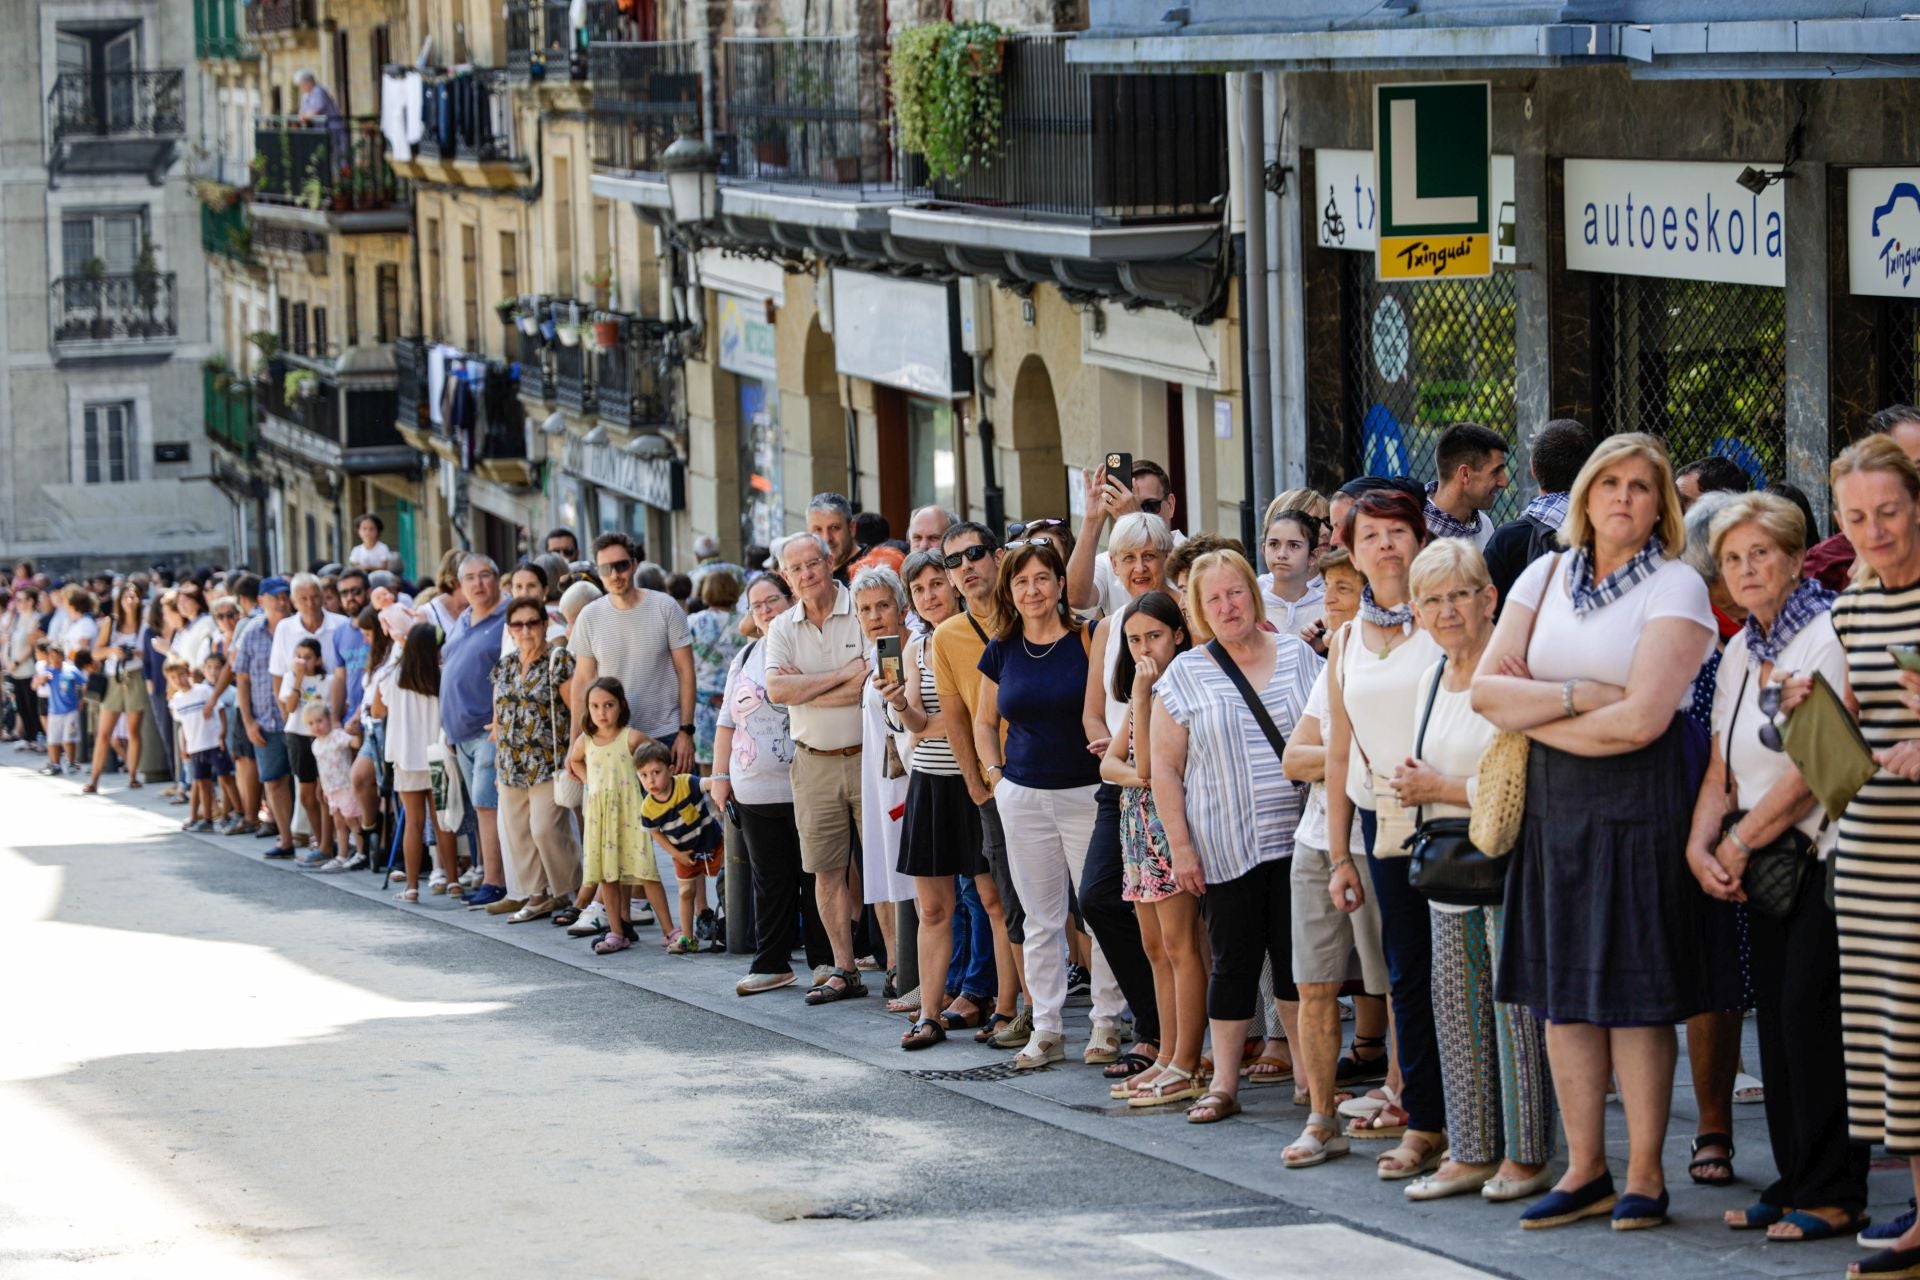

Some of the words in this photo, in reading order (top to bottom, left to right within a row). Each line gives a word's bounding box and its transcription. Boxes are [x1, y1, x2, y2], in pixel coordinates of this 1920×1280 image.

[1389, 99, 1479, 226] L
[1396, 236, 1474, 275] Txingudi
[1583, 192, 1783, 258] autoeskola
